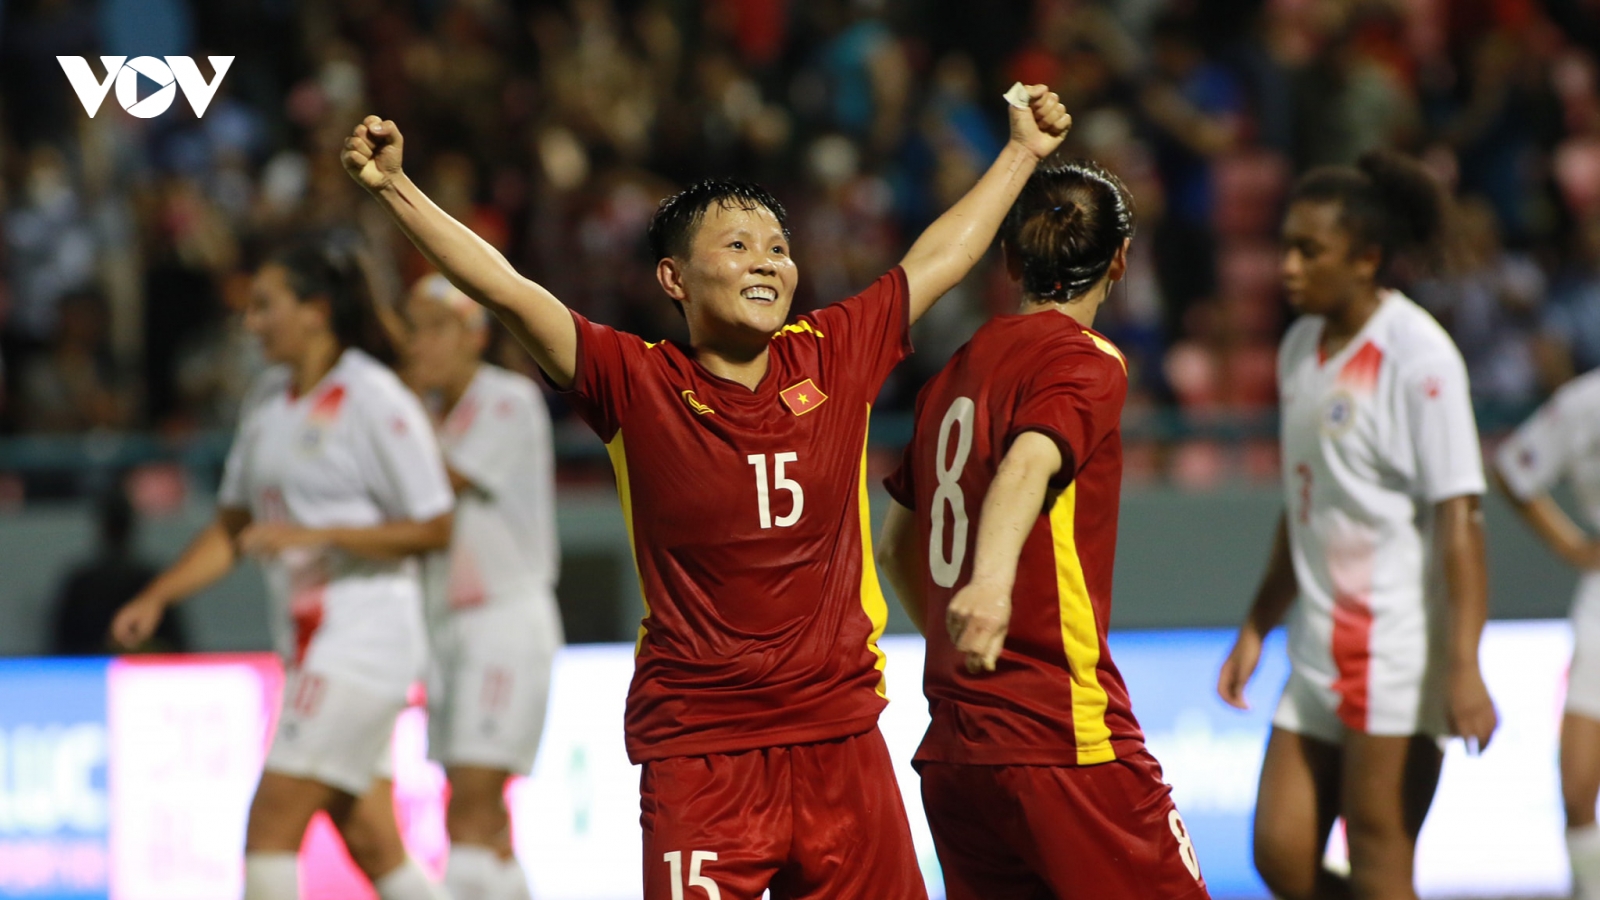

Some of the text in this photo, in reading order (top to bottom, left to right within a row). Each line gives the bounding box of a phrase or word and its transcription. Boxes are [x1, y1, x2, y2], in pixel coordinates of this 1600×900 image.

[747, 452, 804, 529] 15
[929, 397, 974, 588] 8
[663, 850, 721, 900] 15
[1168, 809, 1201, 881] 8
